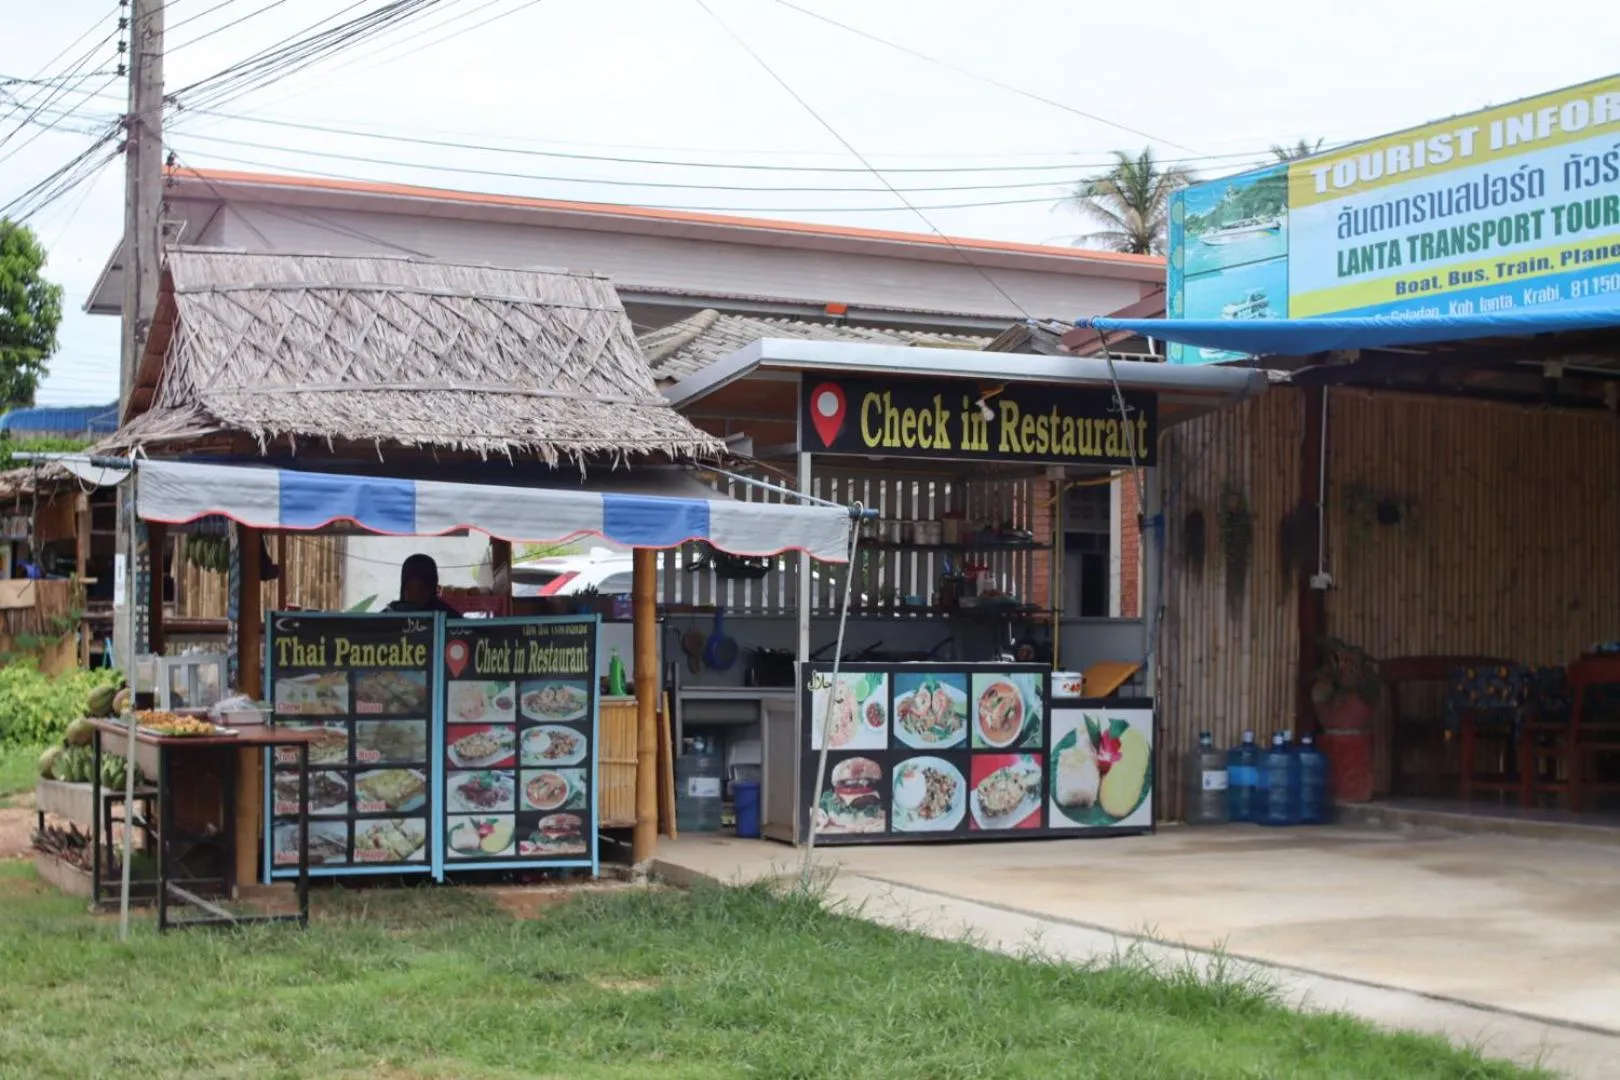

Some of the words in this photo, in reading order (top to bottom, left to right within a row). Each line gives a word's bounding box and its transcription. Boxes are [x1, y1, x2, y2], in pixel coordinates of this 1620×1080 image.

[1310, 125, 1480, 194] TOURIST
[1337, 235, 1401, 278] LANTA
[1408, 208, 1545, 263] TRANSPORT
[1550, 194, 1619, 236] TOUR
[1448, 299, 1474, 317] Koh
[1570, 272, 1620, 299] 81150
[860, 389, 952, 450] Check
[960, 395, 989, 451] in
[998, 399, 1148, 459] Restaurant
[275, 634, 327, 667] Thai
[333, 635, 427, 667] Pancake
[474, 637, 511, 674] Check
[512, 638, 526, 674] in
[527, 639, 589, 674] Restaurant
